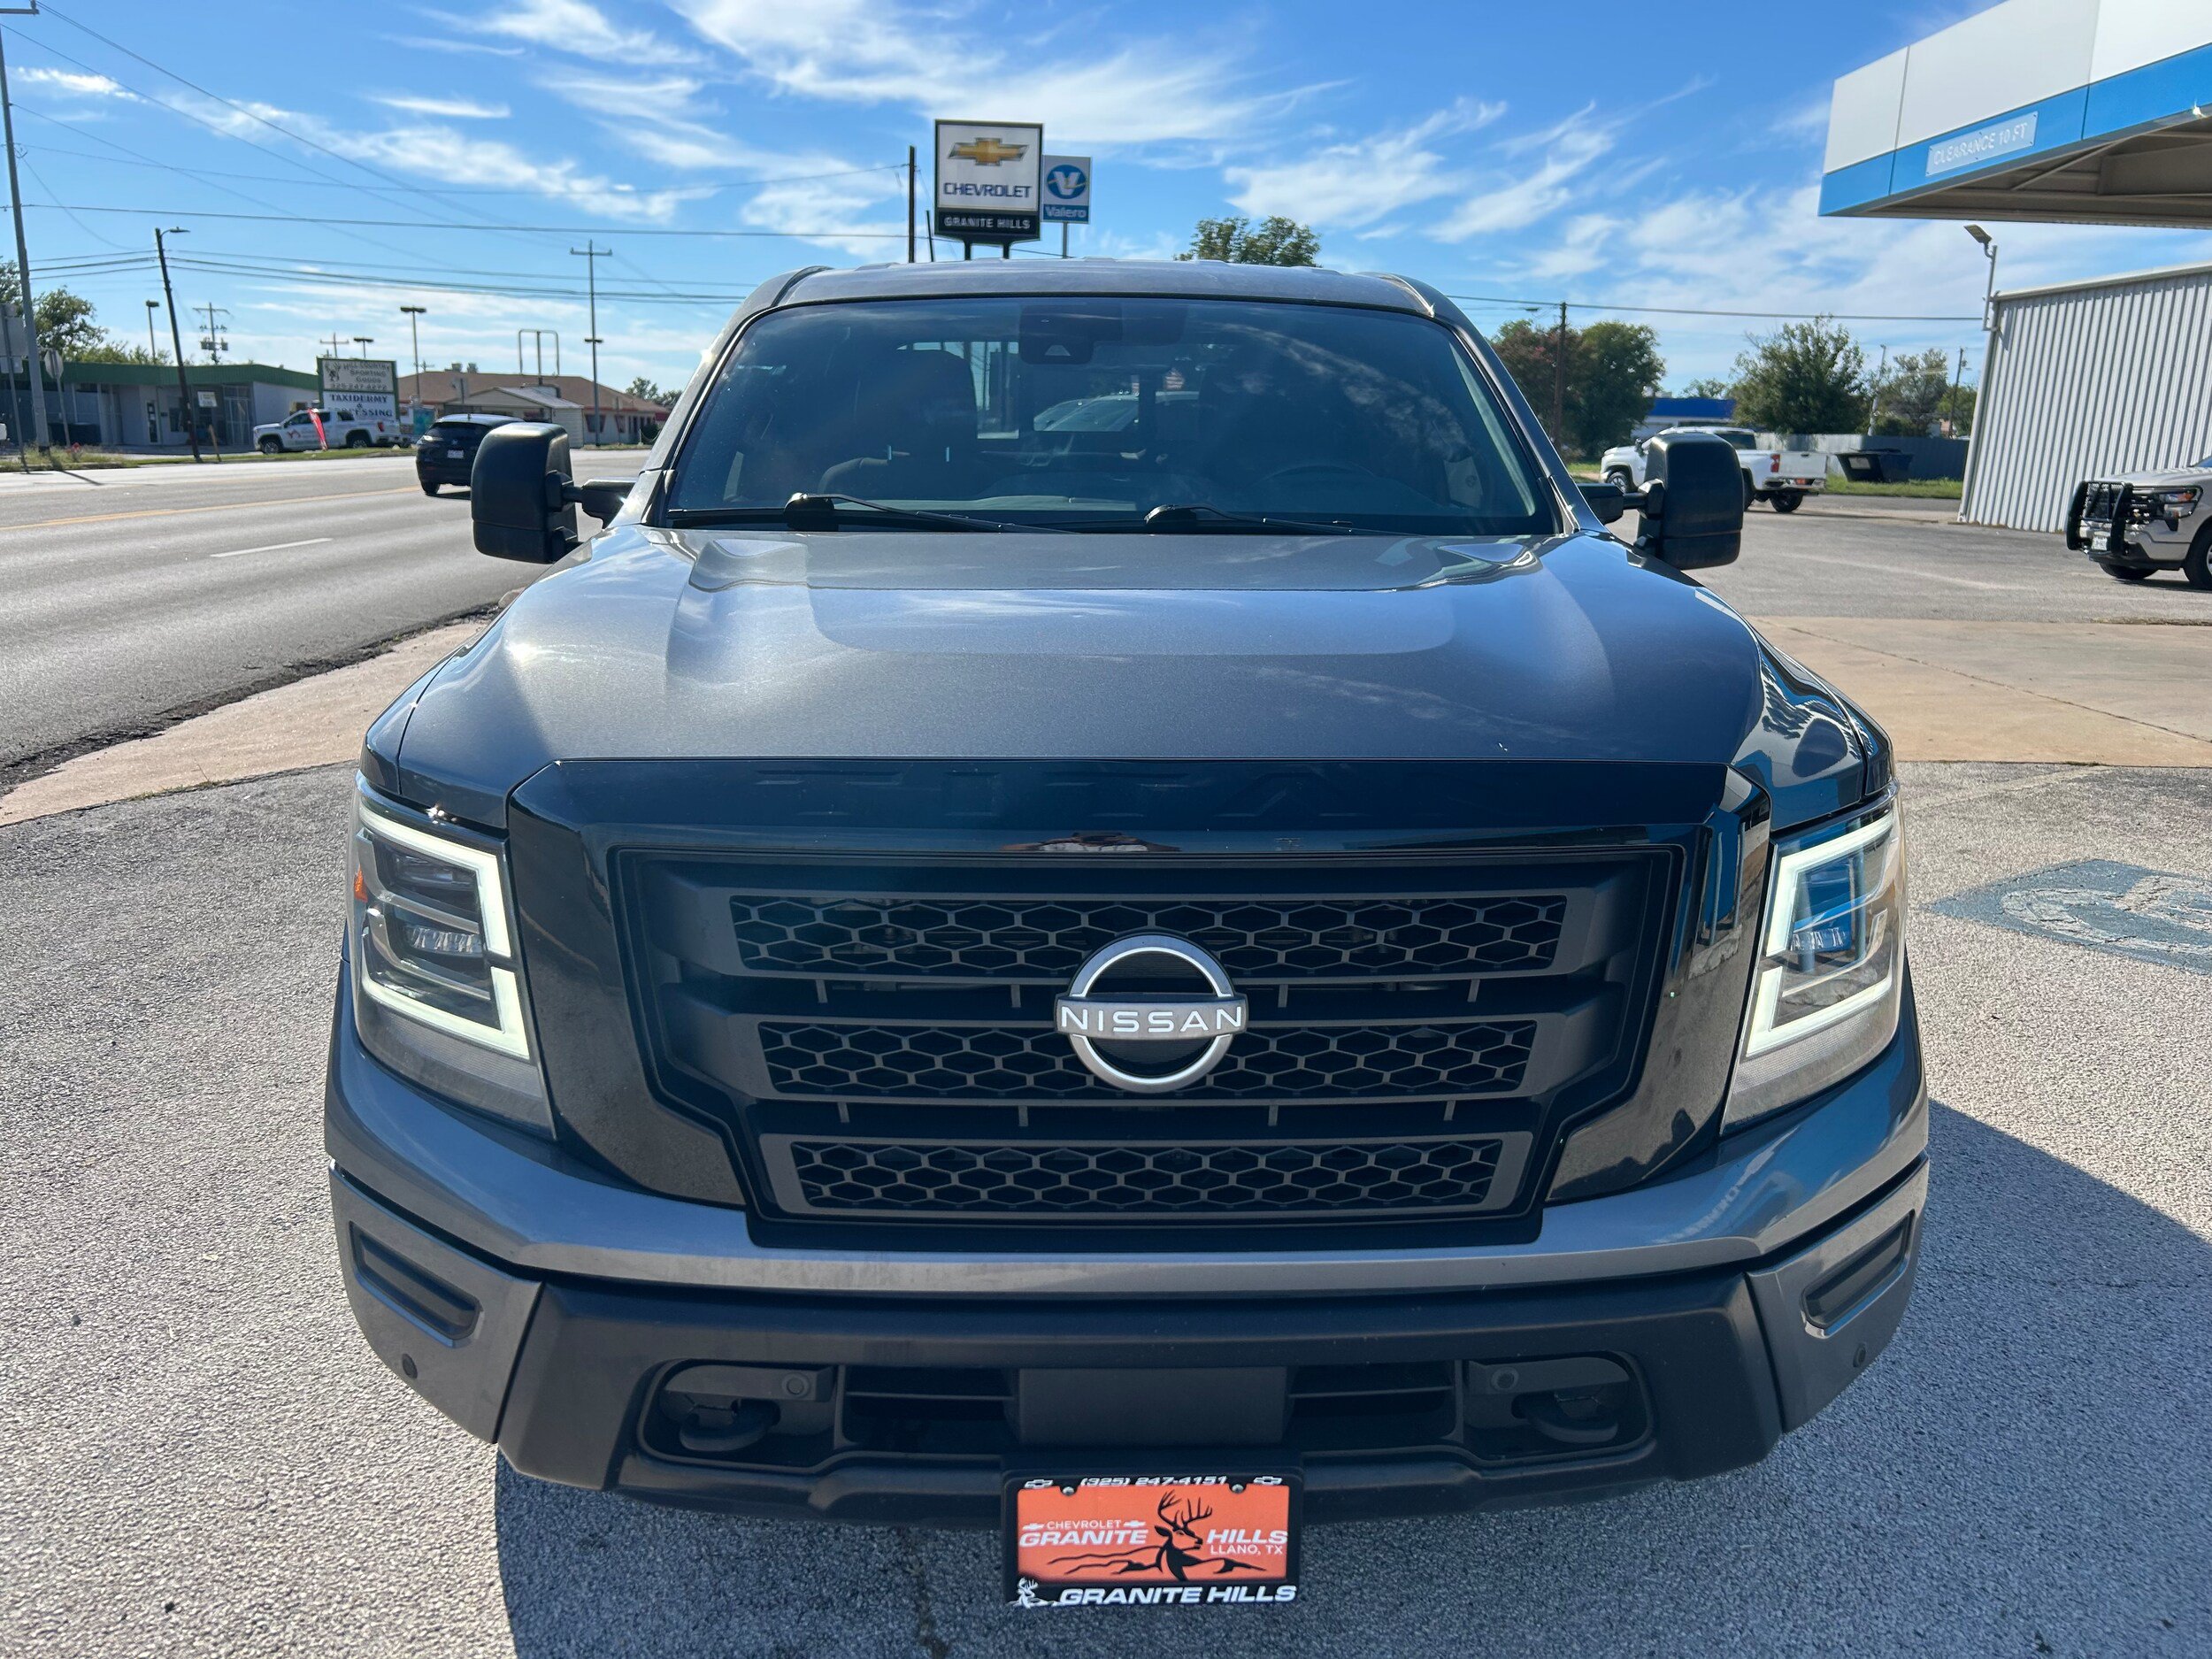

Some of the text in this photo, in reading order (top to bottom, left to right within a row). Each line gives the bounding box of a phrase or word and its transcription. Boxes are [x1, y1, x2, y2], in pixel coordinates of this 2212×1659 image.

[1933, 122, 2028, 165] CLEARANCE 10 FT
[943, 181, 1032, 198] CHEVROLET
[1045, 205, 1087, 218] Valero
[944, 216, 1030, 229] GRANITE HILLS
[330, 394, 388, 403] TAXIDERMY
[1061, 1006, 1242, 1033] NISSAN
[1047, 1520, 1122, 1530] CHEVROLET
[1018, 1529, 1288, 1548] GRANITE HILLS
[1210, 1545, 1284, 1556] LLANO, TX
[1059, 1586, 1298, 1606] GRANITE HILLS
